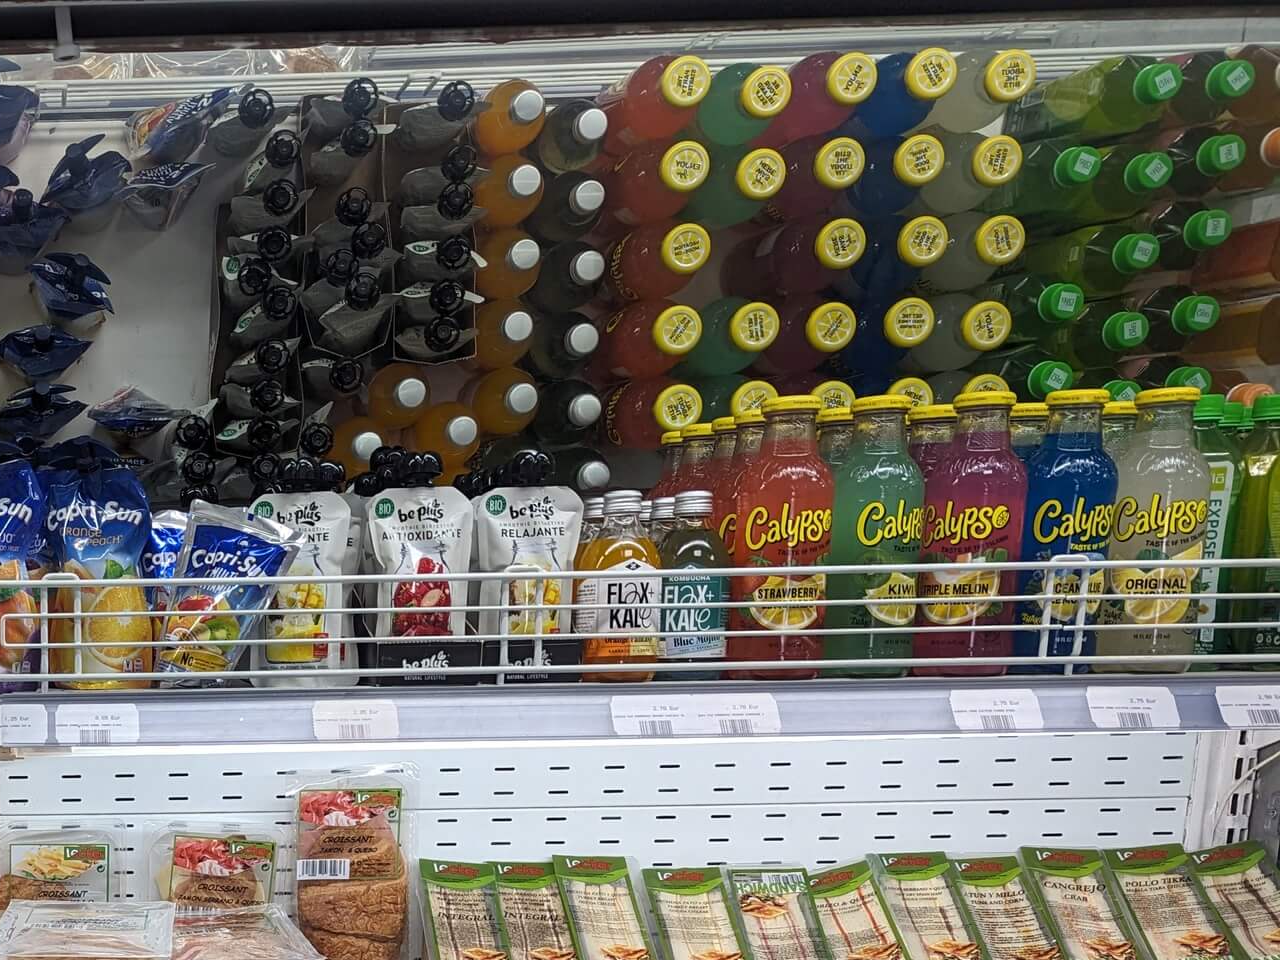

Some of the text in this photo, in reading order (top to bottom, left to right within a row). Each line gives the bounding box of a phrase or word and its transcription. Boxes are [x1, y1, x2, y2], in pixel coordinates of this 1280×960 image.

[856, 499, 921, 546] Calyp
[1033, 496, 1113, 544] Calyps
[1112, 494, 1208, 541] Calypso
[745, 503, 833, 551] Calypso
[922, 500, 1010, 548] Calypso
[501, 527, 565, 538] RELAJANTE
[952, 583, 989, 595] MELON
[1125, 578, 1187, 590] ORIGINAL
[758, 587, 818, 600] STRAWBERRY
[673, 636, 695, 648] Blue
[322, 836, 376, 844] CROISSANT
[197, 883, 249, 894] CROISSANT
[1043, 880, 1107, 895] CANGREJO
[1125, 879, 1159, 888] POLLO
[38, 890, 88, 898] CROISSANT
[438, 911, 496, 922] INTEGRAL
[504, 911, 562, 923] INTEGRAL
